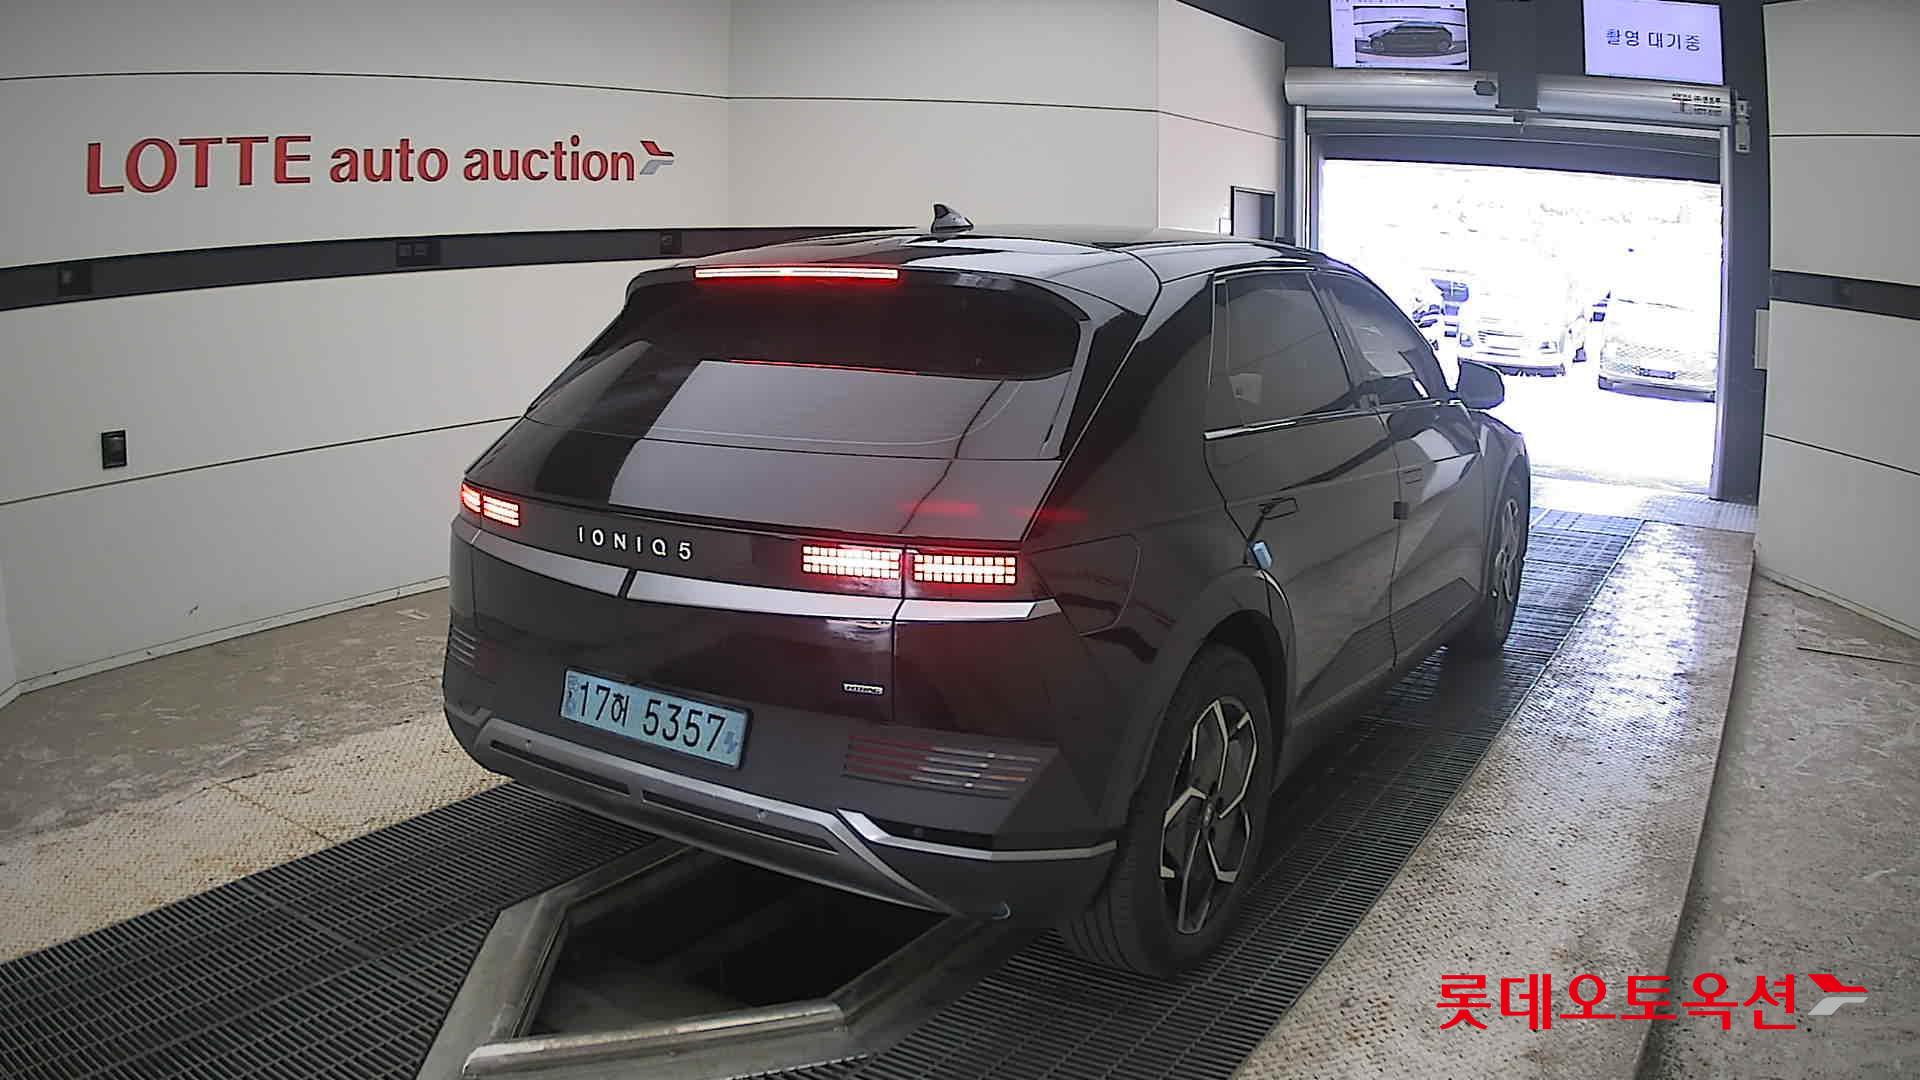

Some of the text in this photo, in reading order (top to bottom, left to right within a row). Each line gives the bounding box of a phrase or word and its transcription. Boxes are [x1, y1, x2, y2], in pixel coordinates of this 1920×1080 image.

[1648, 32, 1701, 52] 대기중
[86, 134, 636, 195] LOTTE auto auction
[577, 525, 693, 561] IONIQ 5
[580, 681, 726, 752] 17허 5357
